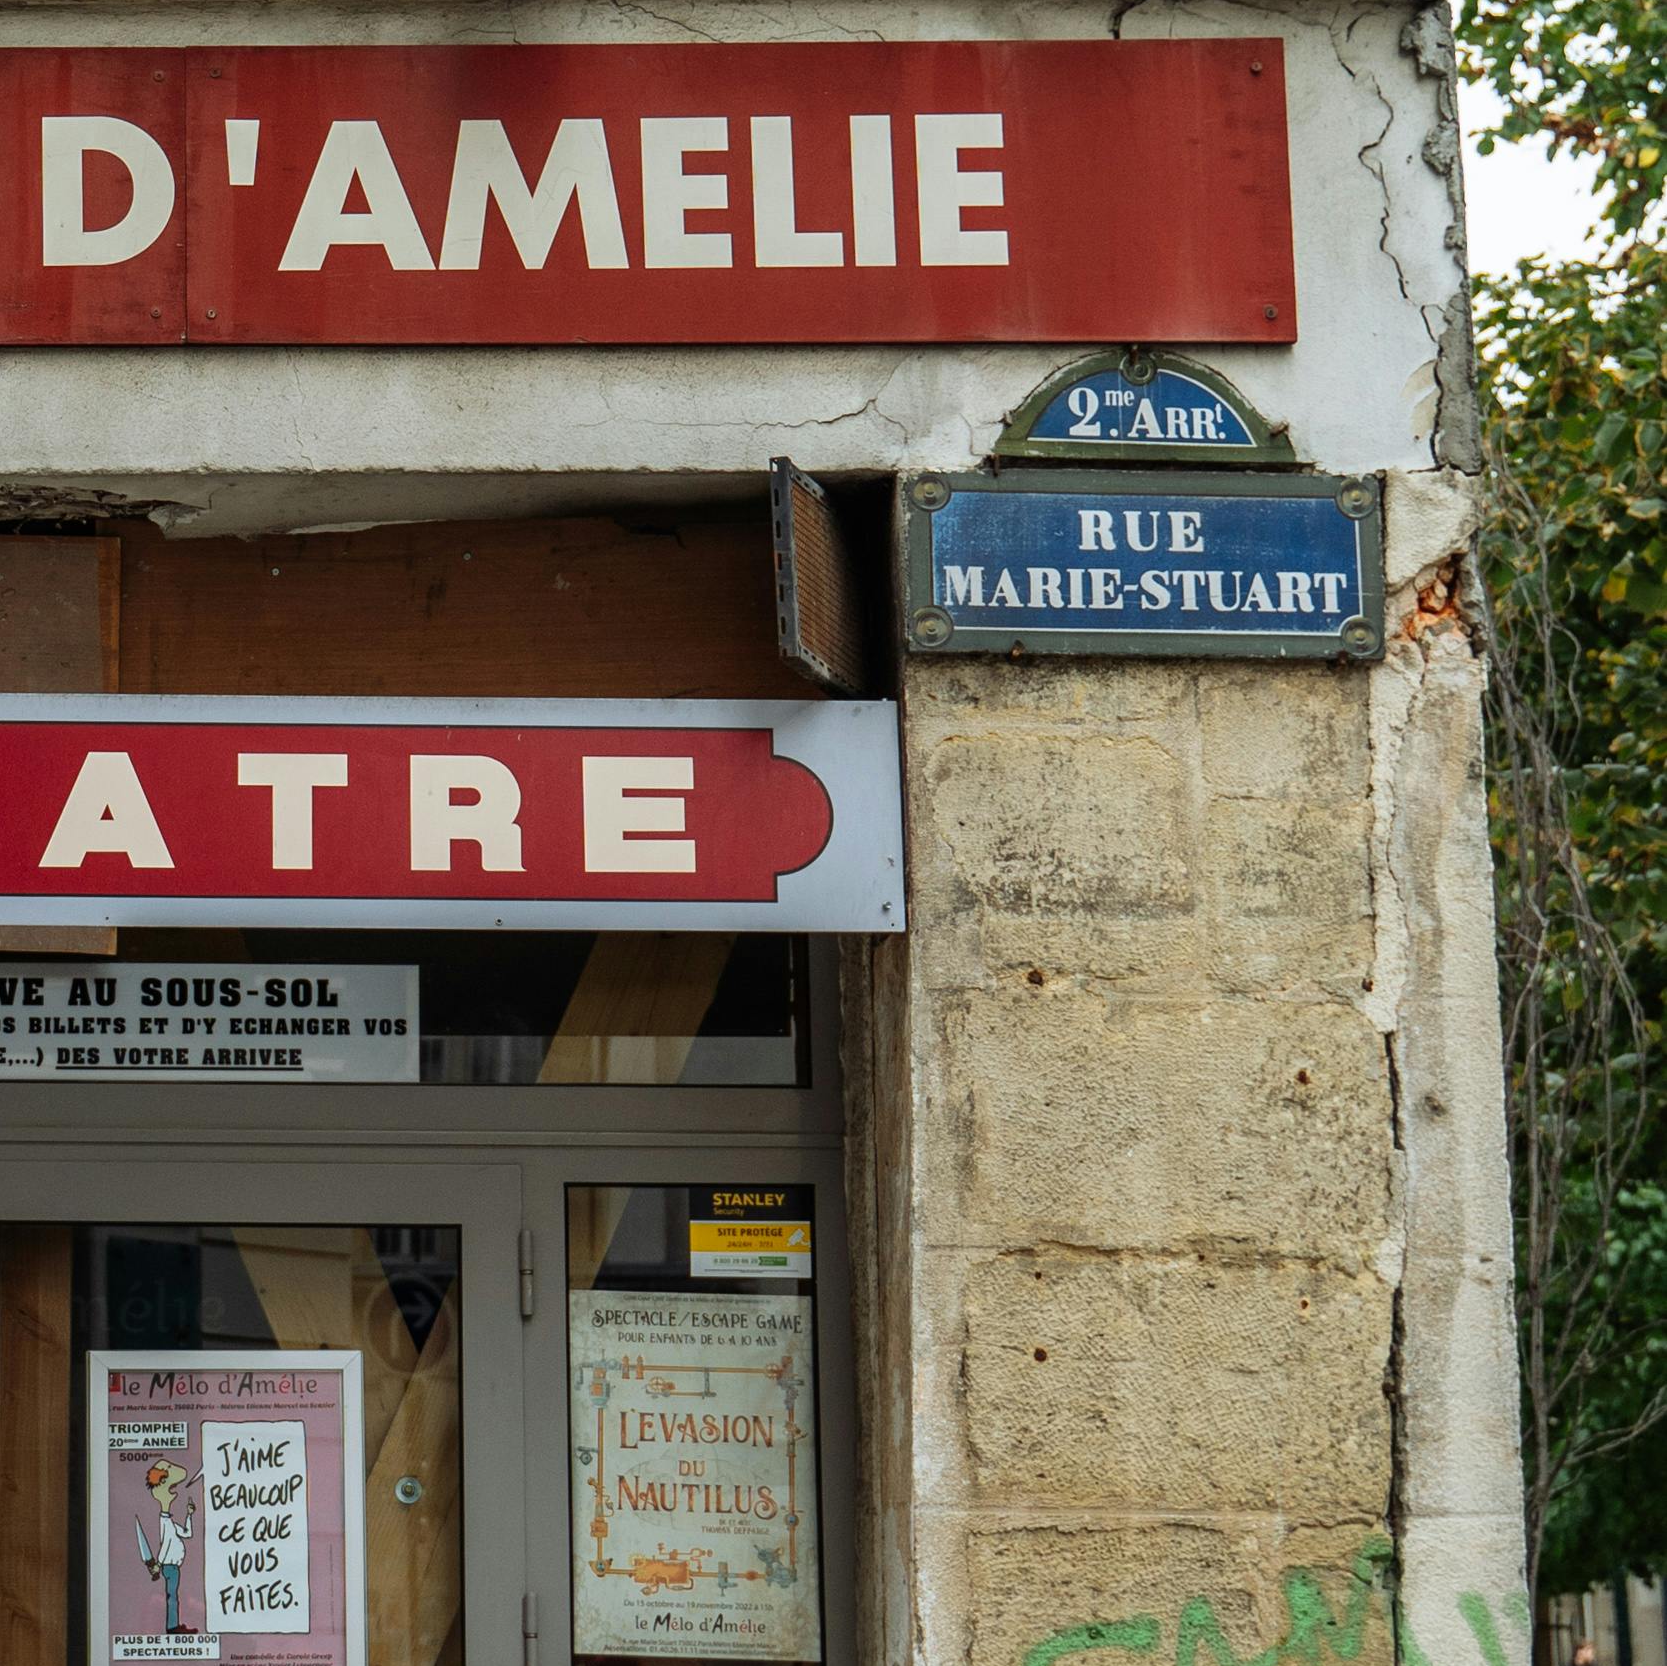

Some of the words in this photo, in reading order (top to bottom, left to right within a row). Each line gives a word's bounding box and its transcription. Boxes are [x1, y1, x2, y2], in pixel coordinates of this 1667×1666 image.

[41, 114, 1012, 272] D'AMELIE
[1078, 510, 1204, 552] RUE
[944, 566, 1347, 613] MARIE-STUART
[68, 977, 116, 1007] AU
[141, 977, 339, 1008] SOUS-SOL
[29, 1016, 126, 1035] BILLETS
[139, 1017, 167, 1035] ET
[180, 1017, 215, 1035] D'Y
[230, 1017, 351, 1036] ECHANGER
[364, 1018, 407, 1036] VOS
[56, 1047, 100, 1068] DES
[114, 1047, 189, 1068] VOTRE
[202, 1048, 303, 1069] ARRIVEE
[712, 1193, 785, 1206] STANLEY
[718, 1228, 737, 1237] SITE
[740, 1227, 783, 1237] PROTÉGÉ
[756, 1314, 803, 1333] GAME
[618, 1332, 644, 1342] POUR
[650, 1333, 696, 1345] ENFANTS
[700, 1334, 714, 1345] DE
[756, 1335, 778, 1347] ANS
[122, 1374, 140, 1395] le
[149, 1373, 209, 1399] Mélo
[110, 1423, 184, 1433] TRIOMPHE!
[142, 1435, 185, 1447] ANNÉE
[678, 1460, 706, 1477] DU
[210, 1474, 303, 1511] BEAUCOUP
[616, 1474, 778, 1520] NAUTILUS
[218, 1517, 246, 1543] CE
[252, 1514, 293, 1543] QUE
[228, 1547, 279, 1578] VOUS
[636, 1615, 648, 1630] le
[653, 1612, 694, 1633] Mélo
[699, 1614, 766, 1636] d'Amélie
[114, 1636, 144, 1645] PLUS
[146, 1636, 162, 1644] DE
[166, 1636, 171, 1644] 1
[175, 1636, 194, 1644] 800
[198, 1636, 218, 1644] 000
[123, 1648, 202, 1657] SPECTATEURS
